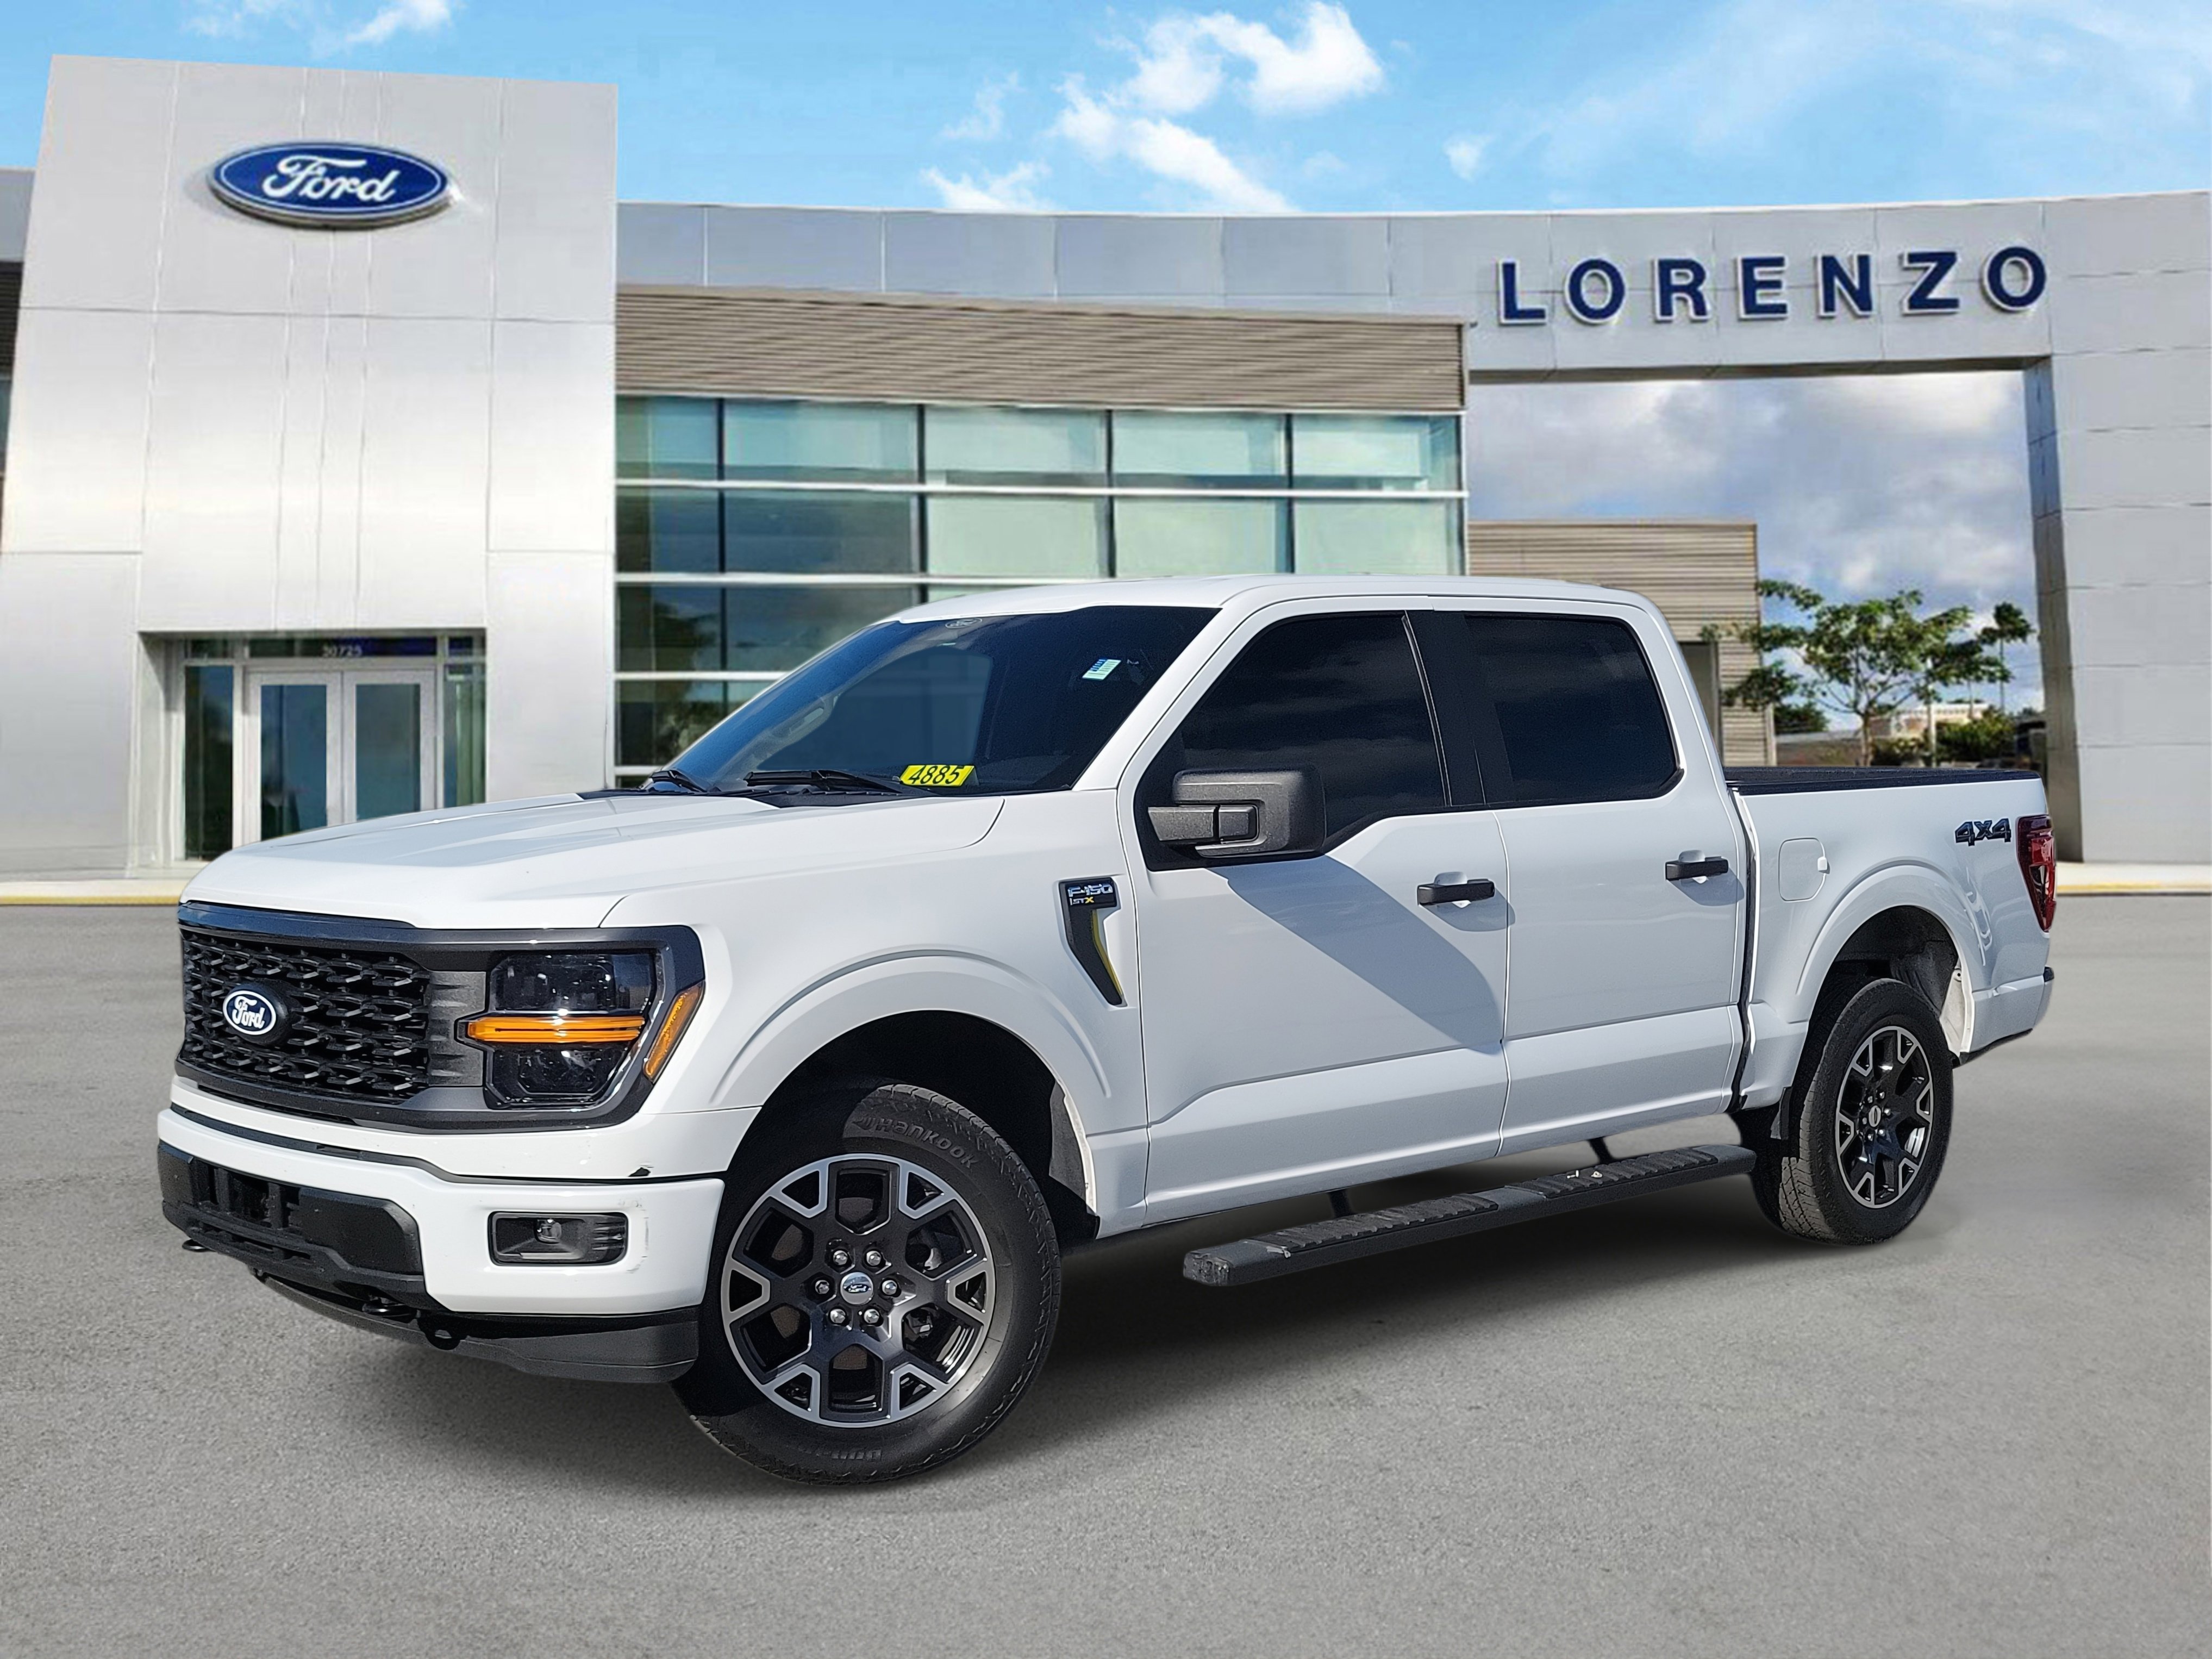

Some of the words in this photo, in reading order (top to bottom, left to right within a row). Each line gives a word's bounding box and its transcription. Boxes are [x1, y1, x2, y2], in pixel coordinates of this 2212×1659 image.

[263, 154, 401, 202] Ford
[1498, 247, 2047, 324] LORENZO
[908, 765, 965, 784] 4885
[1068, 883, 1113, 897] F-150
[232, 996, 265, 1029] Ford
[876, 1118, 978, 1169] Hankook
